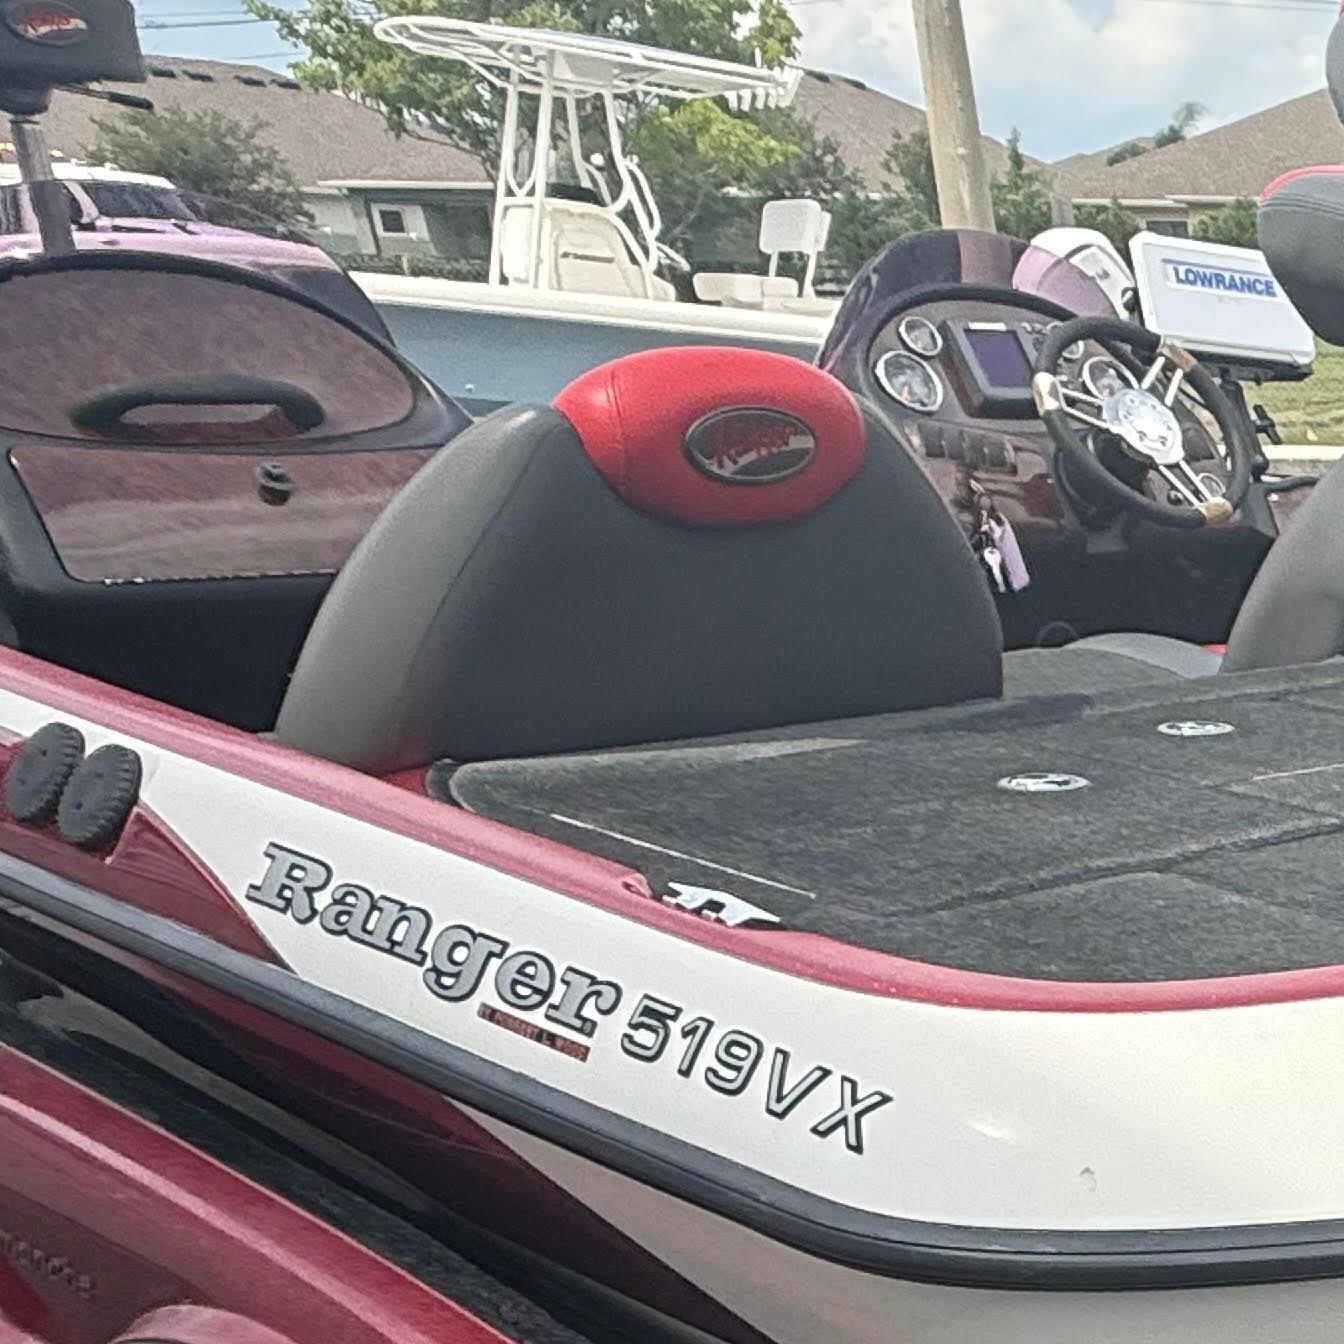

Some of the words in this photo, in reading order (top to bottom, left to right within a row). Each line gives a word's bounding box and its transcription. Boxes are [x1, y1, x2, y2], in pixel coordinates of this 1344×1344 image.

[1173, 266, 1277, 297] LOWRANCE
[245, 841, 622, 1037] Ranger
[620, 993, 893, 1155] 519VX
